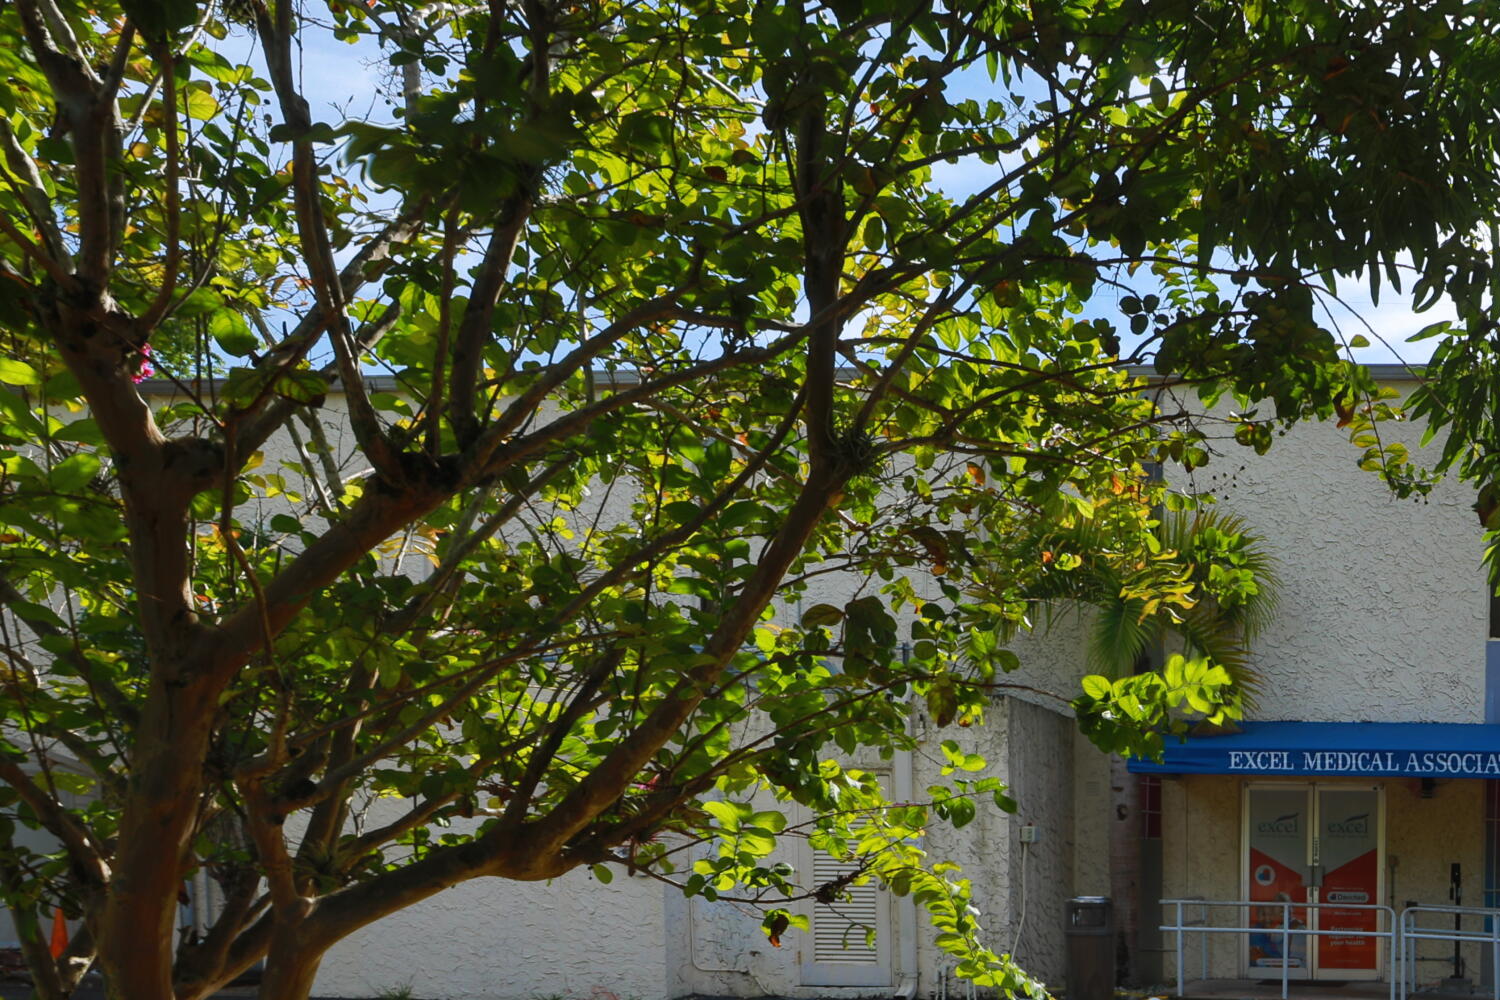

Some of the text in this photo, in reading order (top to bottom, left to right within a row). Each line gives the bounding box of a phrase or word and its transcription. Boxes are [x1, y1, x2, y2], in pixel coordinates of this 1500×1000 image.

[1228, 751, 1294, 770] EXCEL
[1302, 752, 1399, 771] MEDICAL
[1257, 815, 1298, 833] excel
[1327, 816, 1369, 833] excel
